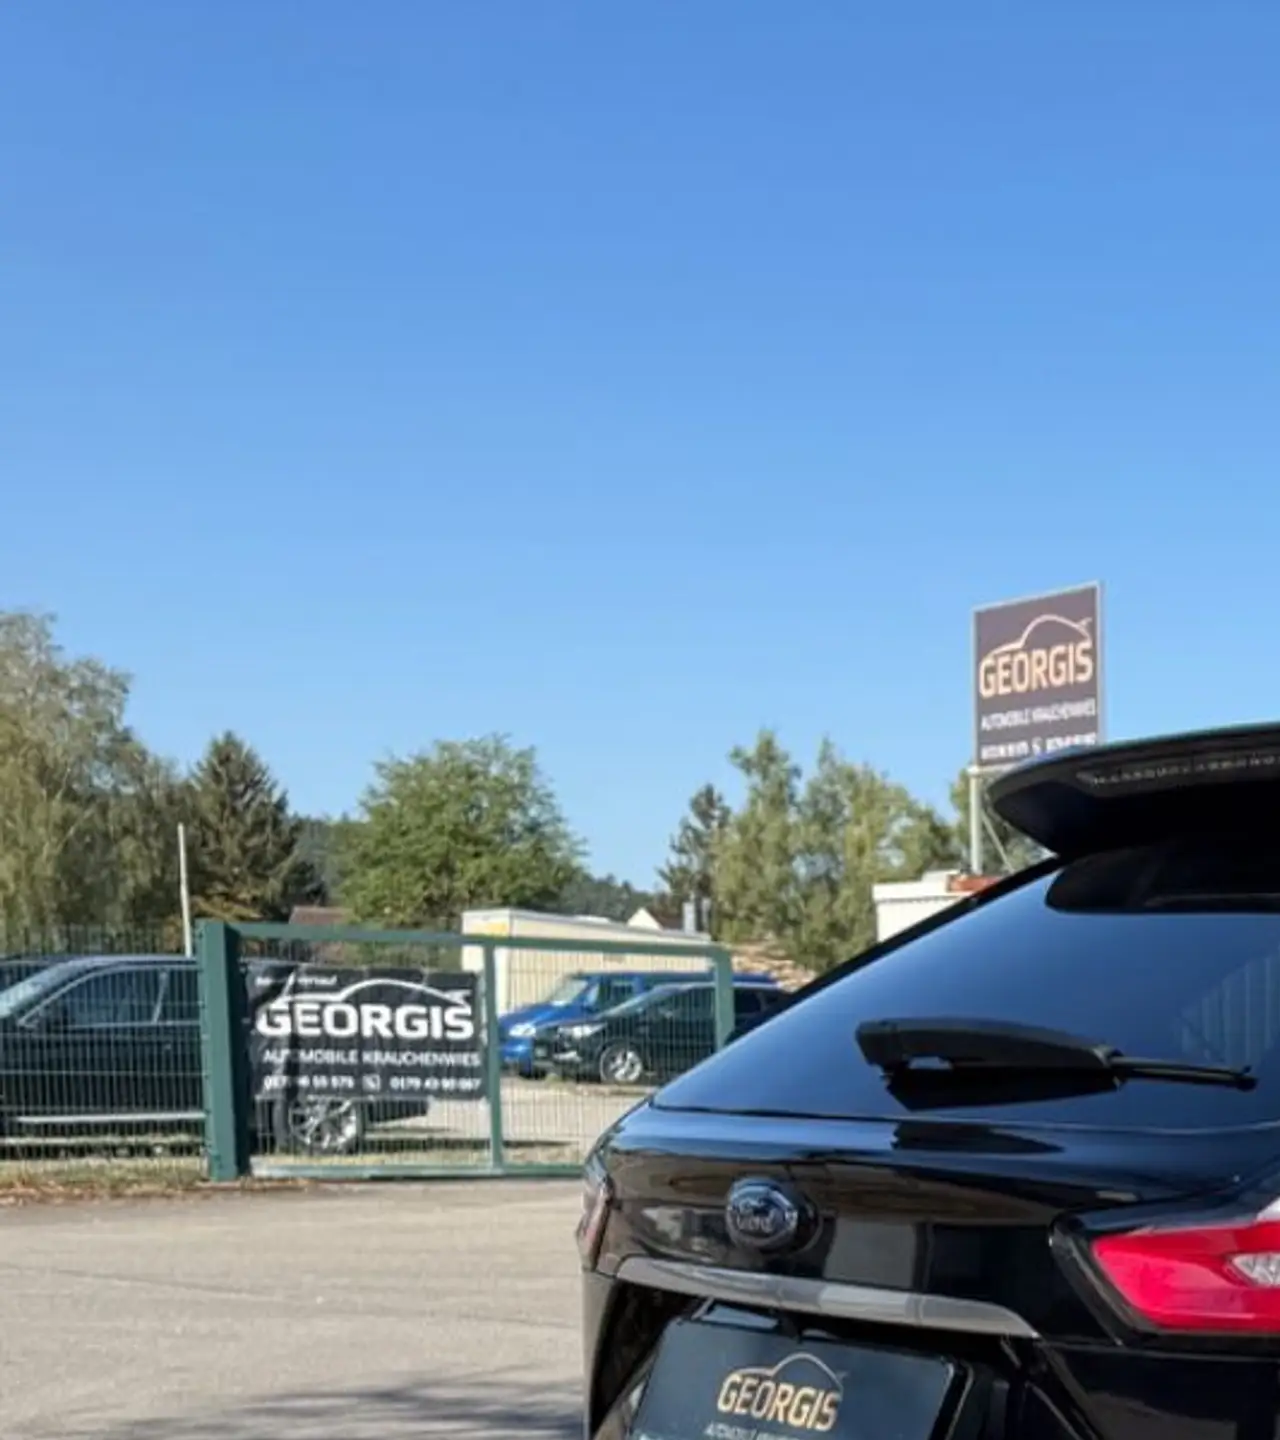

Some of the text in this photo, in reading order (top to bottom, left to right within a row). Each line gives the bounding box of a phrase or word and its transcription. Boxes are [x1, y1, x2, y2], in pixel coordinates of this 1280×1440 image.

[979, 641, 1093, 698] GEORGIS
[255, 1003, 475, 1040] GEORGIS
[263, 1050, 481, 1068] AUTMOBILE KRAUCHENWIES
[716, 1373, 840, 1432] GEORGIS
